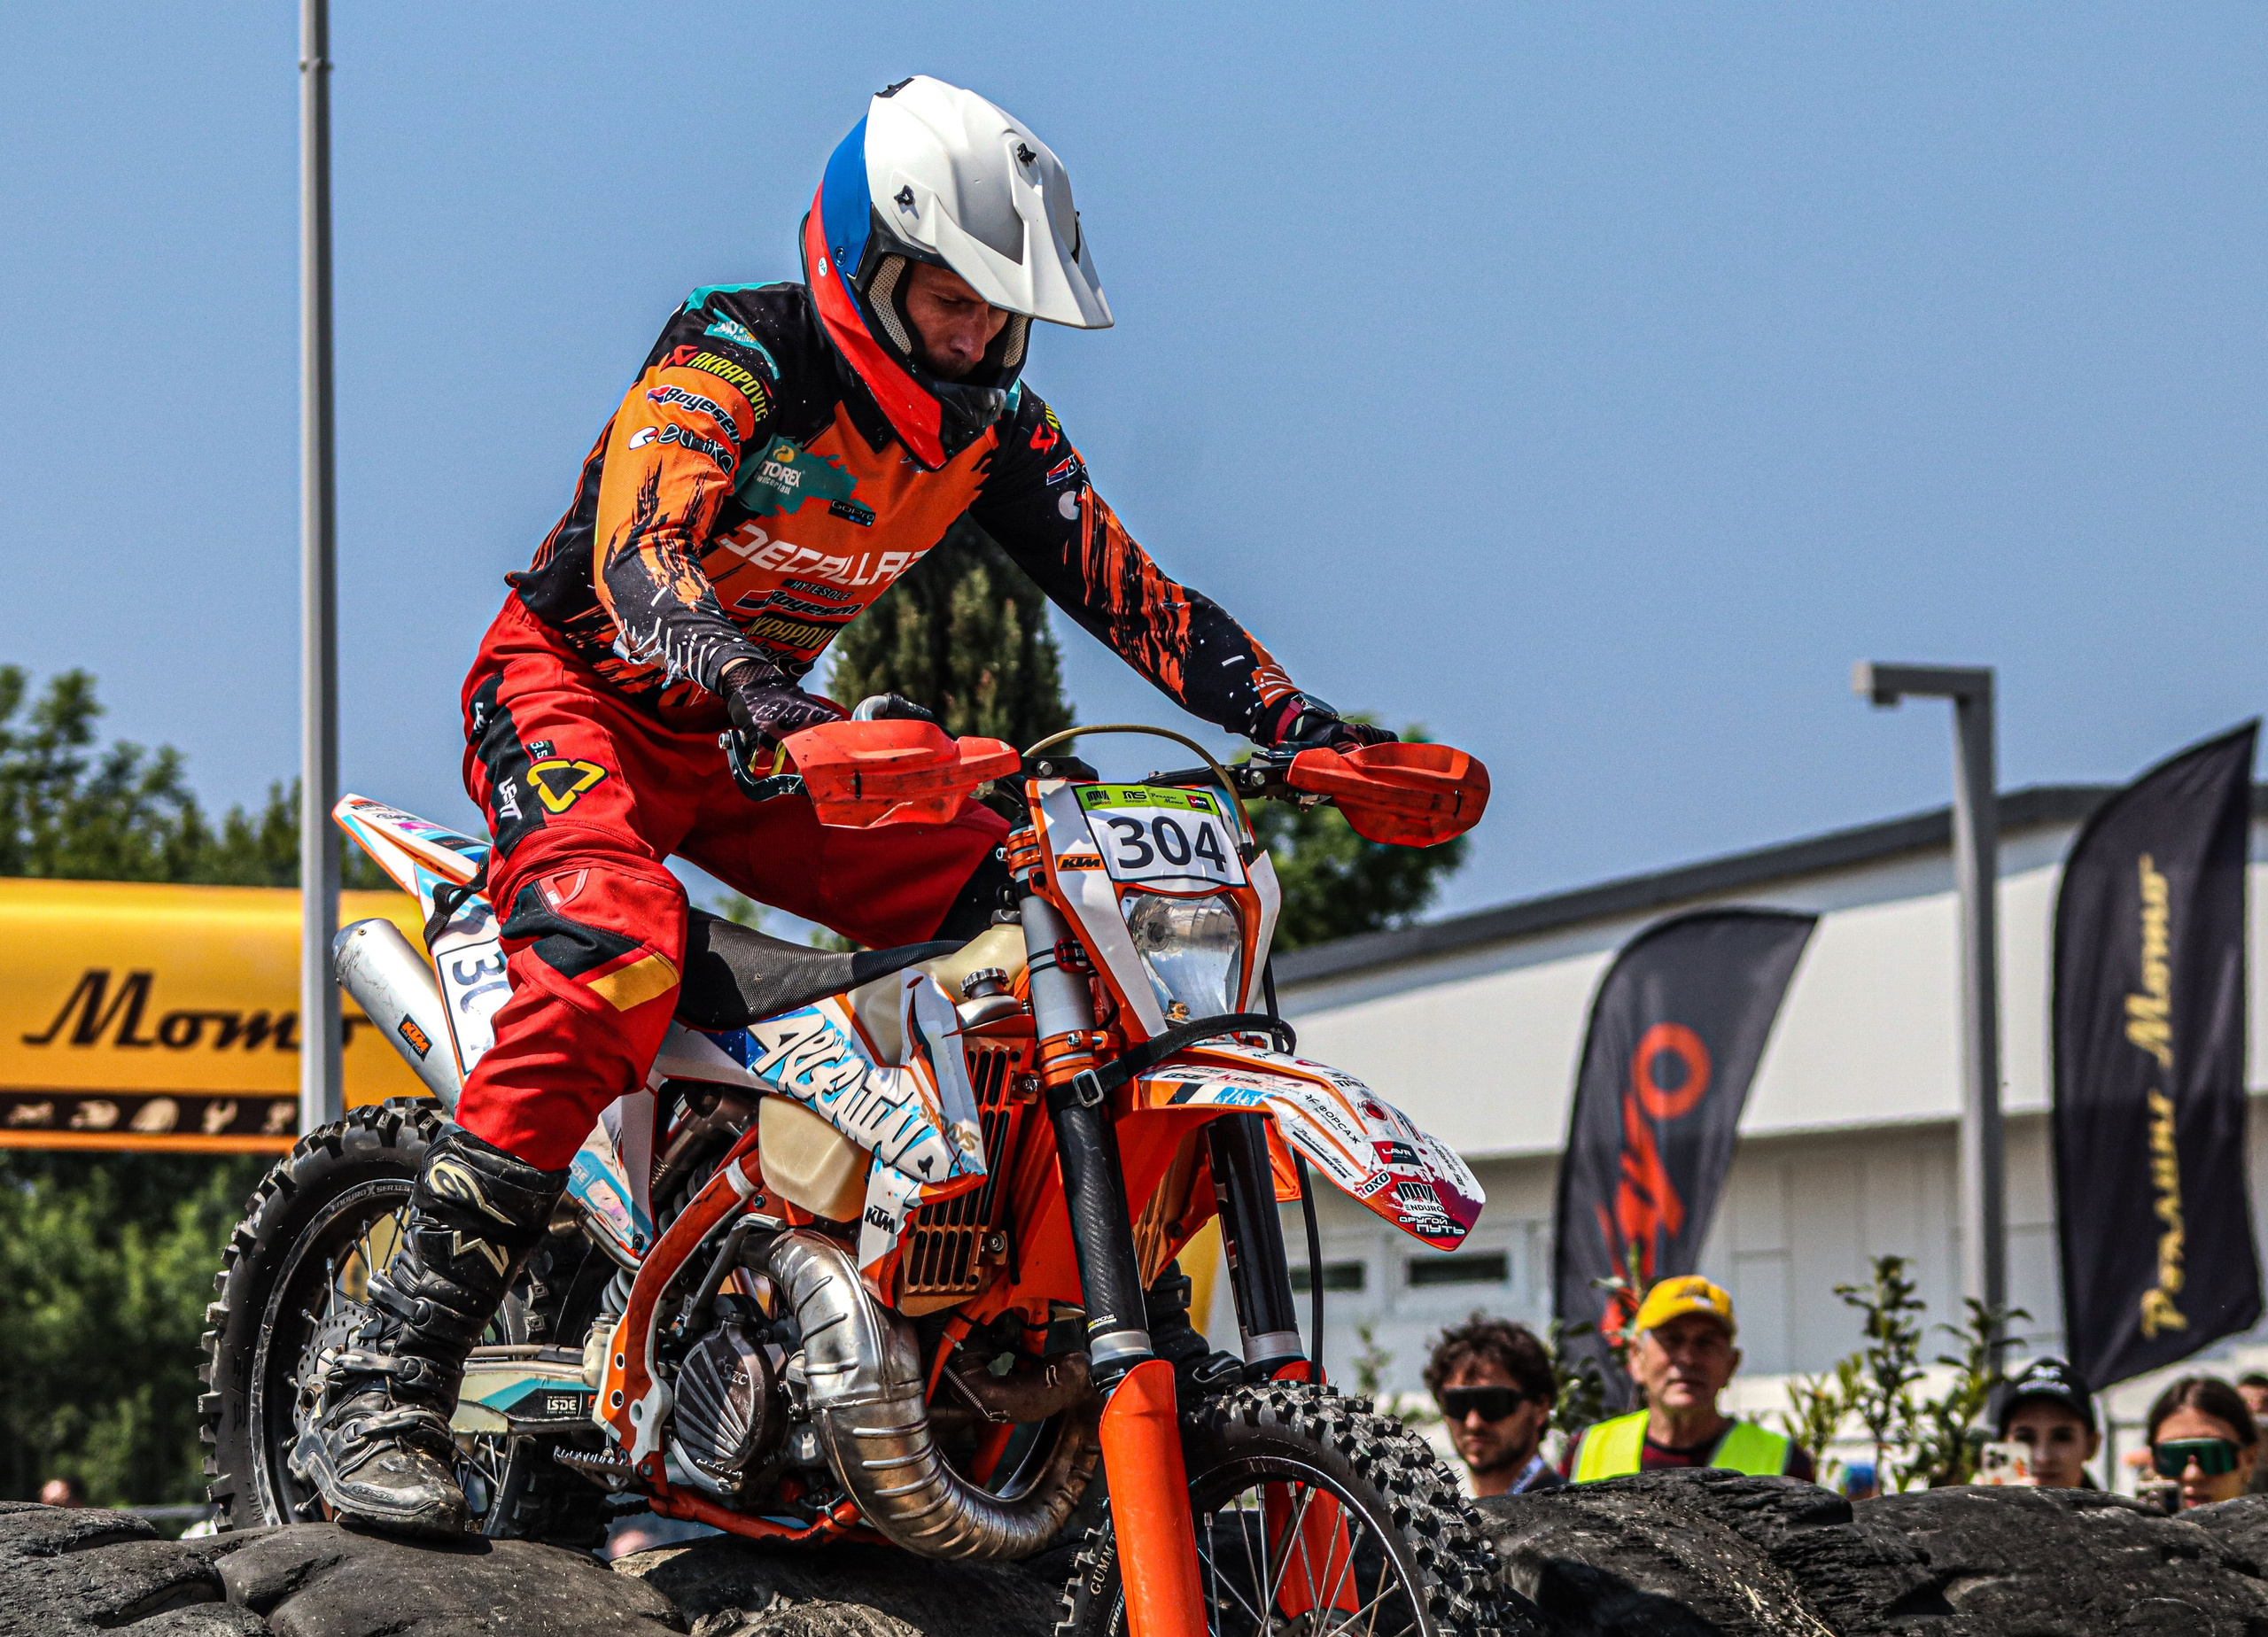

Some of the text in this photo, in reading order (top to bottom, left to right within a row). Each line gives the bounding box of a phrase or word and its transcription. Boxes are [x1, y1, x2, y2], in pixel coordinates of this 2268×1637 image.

[757, 460, 802, 488] TOREX
[831, 500, 874, 522] GoPro
[530, 741, 548, 759] 3.5
[1107, 816, 1227, 873] 304
[1062, 856, 1100, 868] KTM
[400, 1021, 430, 1052] KTM
[1319, 1105, 1361, 1144] ФОРСАЖ
[1382, 1147, 1412, 1157] LAVR
[1404, 1204, 1444, 1213] ENDURO
[865, 1204, 895, 1234] KTM
[1399, 1215, 1448, 1224] ДРУГОЙ
[1418, 1223, 1465, 1235] ПУТЬ
[547, 1400, 577, 1410] ISDE
[1108, 1590, 1125, 1637] ENDU
